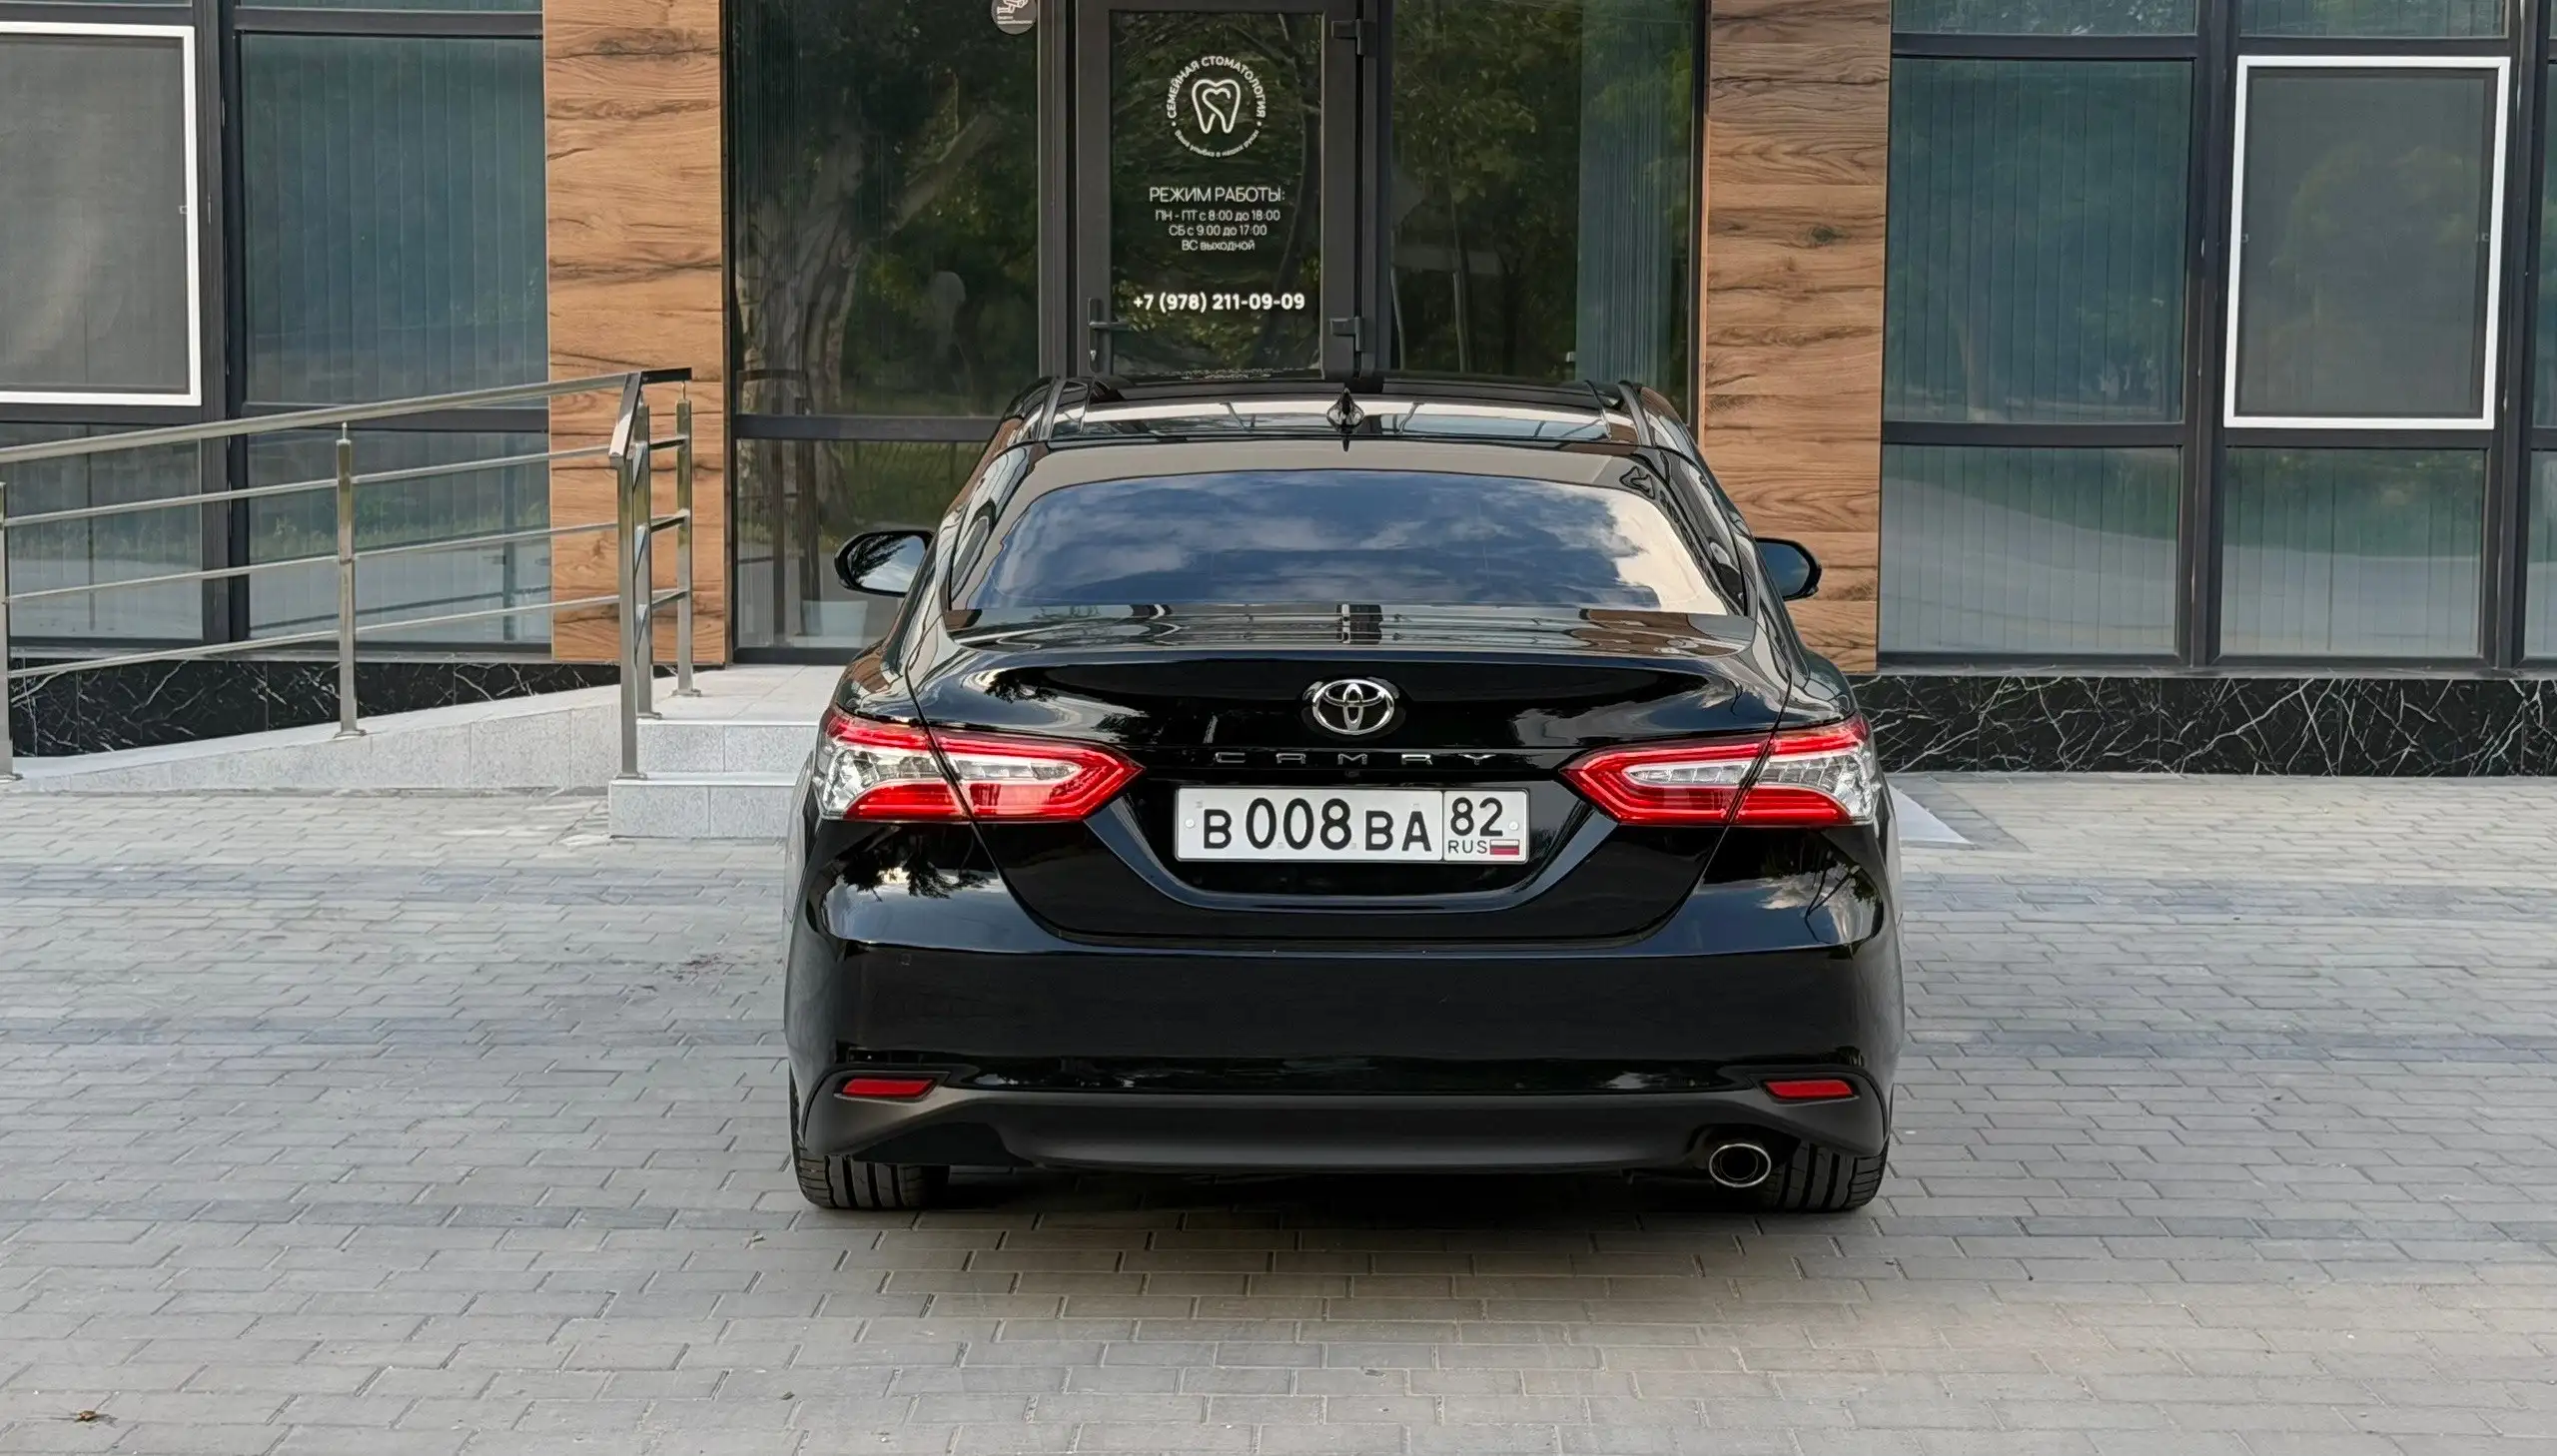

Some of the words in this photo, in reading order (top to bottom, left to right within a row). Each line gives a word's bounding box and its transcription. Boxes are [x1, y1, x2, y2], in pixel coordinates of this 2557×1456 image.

[1166, 60, 1200, 119] СЕМЕЙНАЯ
[1201, 56, 1267, 118] СТОМАТОЛОГИЯ
[1149, 187, 1212, 203] РЕЖИМ
[1215, 187, 1285, 203] РАБОТЫ:
[1155, 209, 1173, 222] ПН
[1182, 209, 1198, 222] ПТ
[1235, 211, 1250, 223] до
[1252, 209, 1280, 222] 18:00
[1169, 224, 1186, 237] СБ
[1223, 227, 1238, 238] до
[1181, 240, 1199, 252] ВС
[1200, 240, 1255, 252] выходной
[1133, 293, 1155, 311] +7
[1159, 292, 1208, 314] (978)
[1212, 293, 1305, 311] 211-09-09
[1215, 751, 1496, 766] CAMRY
[1450, 796, 1504, 837] 82
[1447, 839, 1488, 855] RUS
